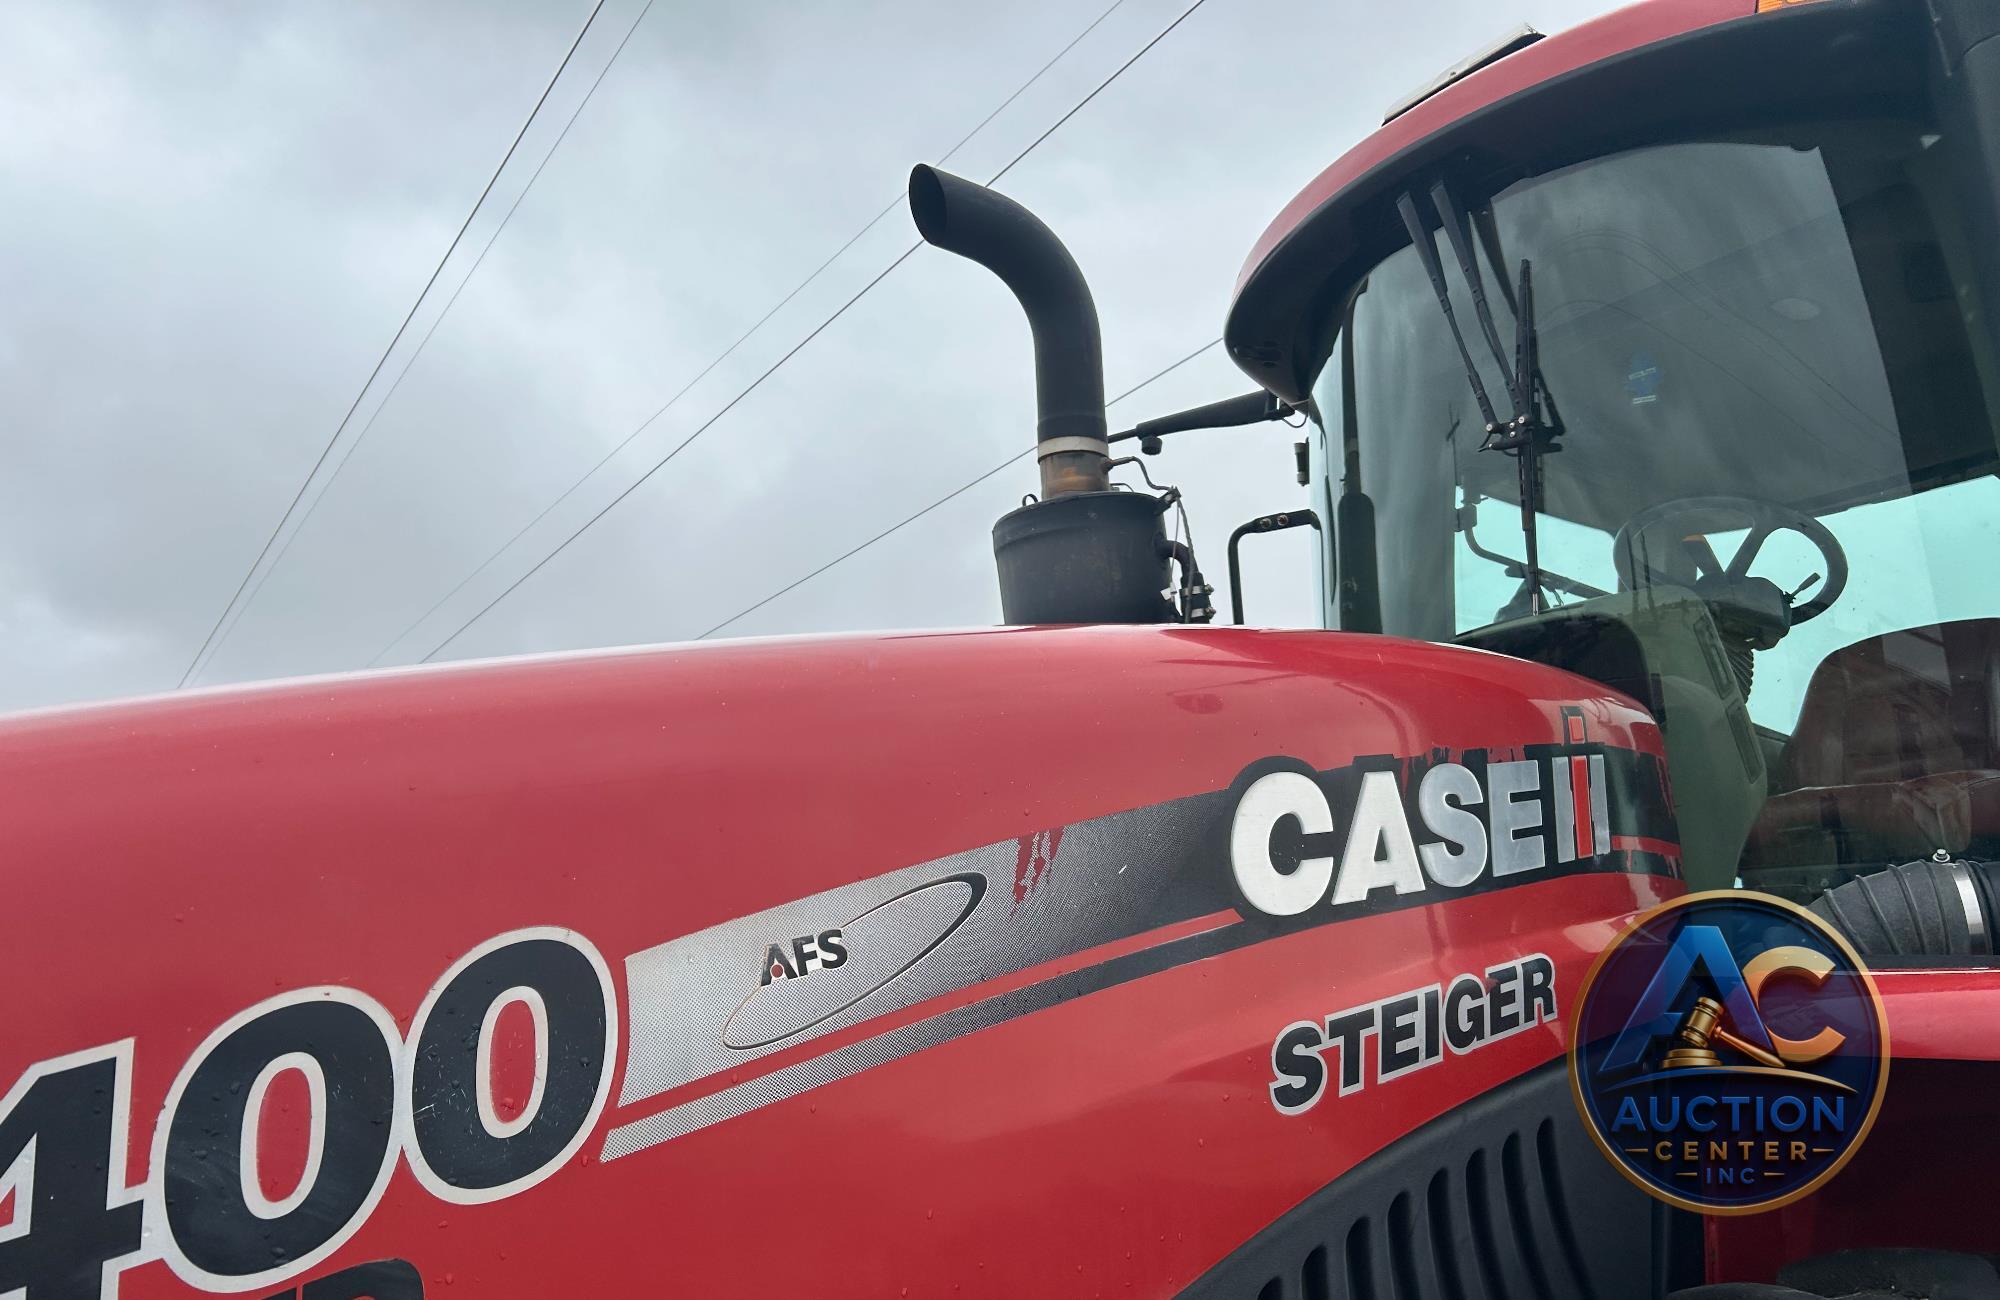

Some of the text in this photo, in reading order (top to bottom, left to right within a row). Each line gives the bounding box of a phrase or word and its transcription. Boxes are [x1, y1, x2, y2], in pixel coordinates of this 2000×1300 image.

[1230, 758, 1546, 916] CASE
[760, 929, 848, 986] AFS
[1268, 953, 1559, 1117] STEIGER
[0, 925, 618, 1300] 400
